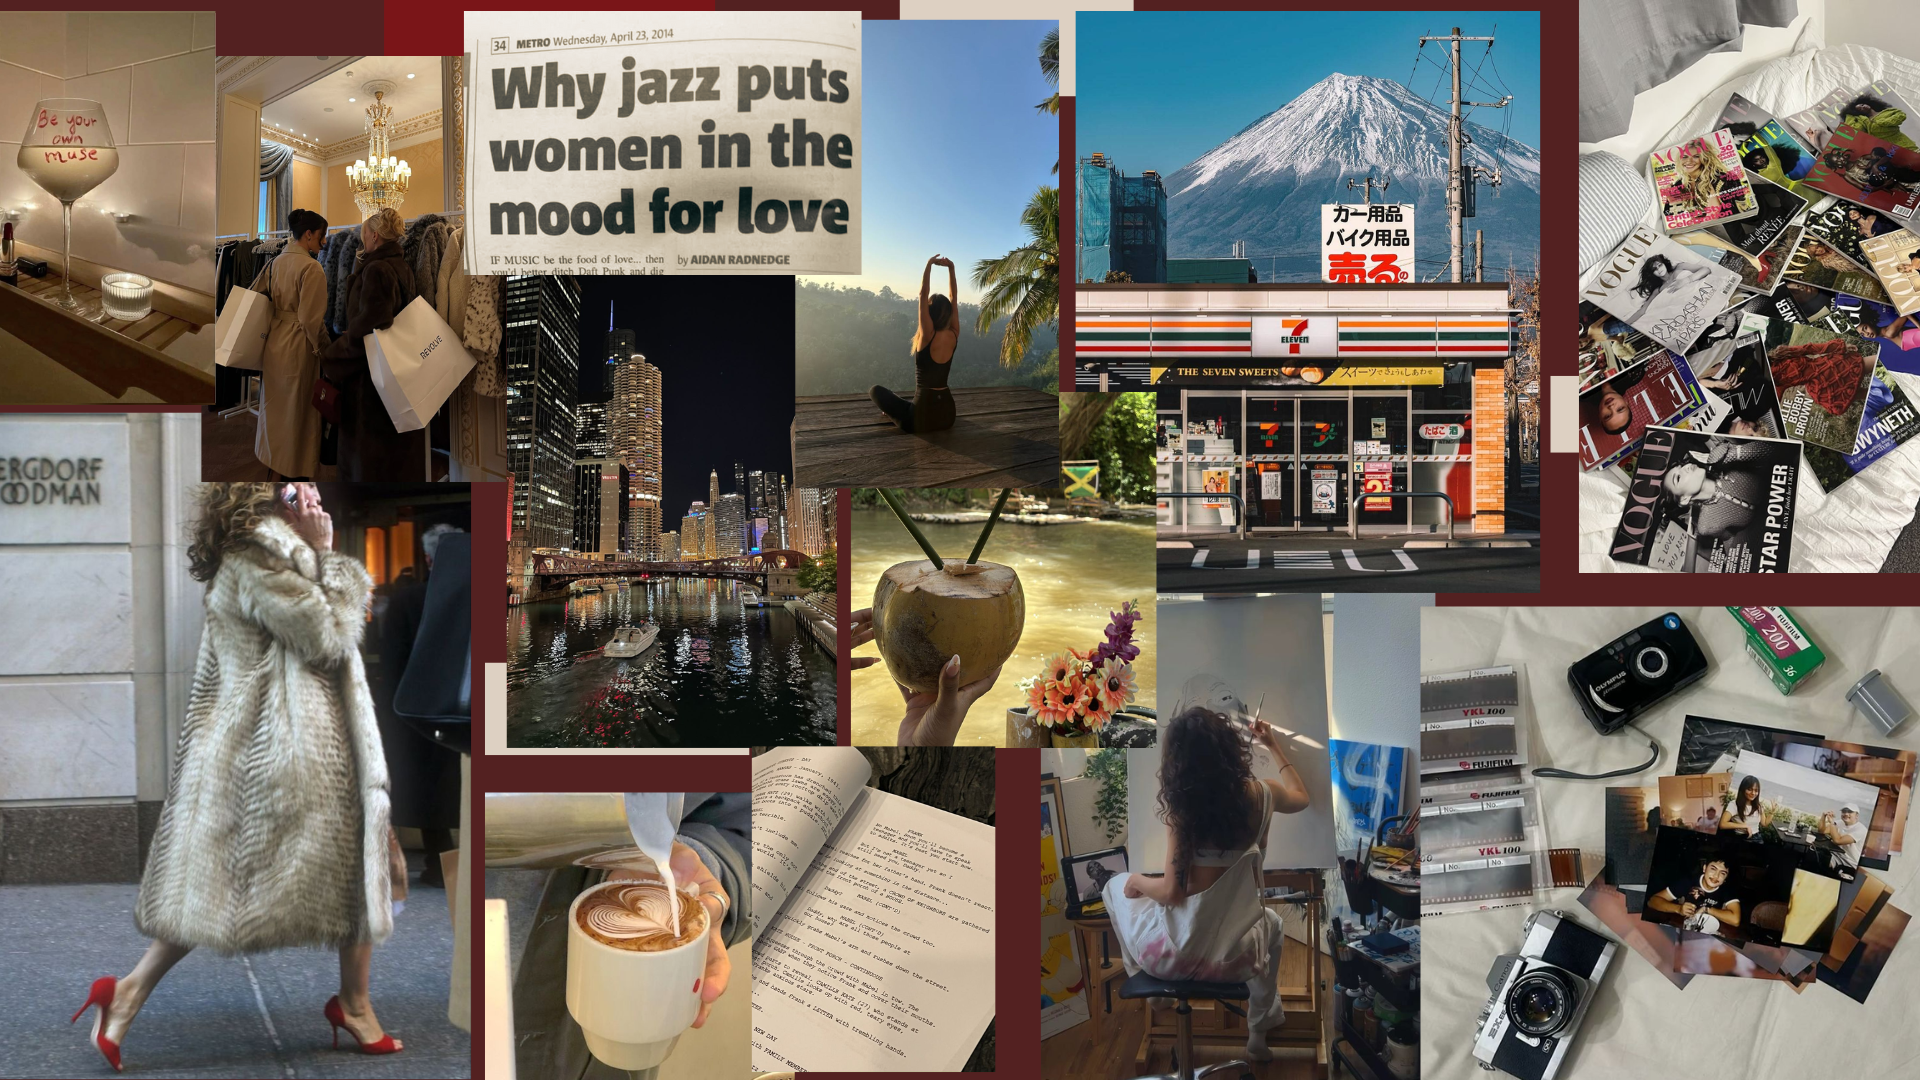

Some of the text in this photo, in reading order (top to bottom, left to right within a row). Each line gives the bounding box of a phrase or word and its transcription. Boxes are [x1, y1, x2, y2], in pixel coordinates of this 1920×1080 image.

[493, 29, 674, 51] 34 METRO Wednesday, April 23, 2014
[491, 56, 849, 119] Why jazz puts
[37, 109, 97, 134] Be your
[52, 133, 83, 145] own
[489, 118, 853, 172] women in the
[1653, 128, 1732, 166] VOGUE
[45, 149, 98, 163] muse
[490, 186, 849, 236] mood for love
[1333, 206, 1403, 222] カー用品
[1666, 202, 1732, 223] British Style
[1667, 210, 1732, 230] Celebration
[1326, 228, 1409, 247] バイク用品
[1740, 220, 1770, 250] Mad about
[1757, 214, 1786, 245] RENÉE
[490, 255, 664, 264] IF MUSIC be the food of love... then
[678, 255, 790, 266] by AIDAN RADNEDGE
[1585, 227, 1658, 299] VOGUE
[579, 267, 598, 275] Daft
[603, 267, 625, 275] Punk
[630, 267, 645, 275] and
[419, 335, 443, 360] REVOLVE
[1178, 368, 1278, 376] THE SEVEN SWEETS
[1787, 391, 1805, 425] BOBBY
[1795, 397, 1814, 436] BROWN
[1425, 426, 1445, 435] たばこ
[1786, 465, 1795, 485] LIGHT
[1613, 431, 1675, 555] VOGUE
[1763, 462, 1791, 528] POWER
[1660, 532, 1676, 554] LOVE
[1666, 552, 1679, 569] YOU
[1760, 624, 1790, 650] 200
[1776, 613, 1800, 640] FUJIFILM
[1782, 664, 1797, 676] 36
[1595, 670, 1627, 694] OLYMPUS
[1462, 707, 1505, 716] YKL 100
[1473, 759, 1513, 769] FUJIFILM
[1481, 789, 1520, 798] FUJIFILM
[1478, 845, 1521, 855] YKL 100
[890, 924, 901, 932] the
[894, 964, 910, 974] down
[911, 971, 923, 980] the
[1492, 960, 1513, 992] Canon
[752, 1025, 778, 1042] NEW DAY
[834, 1016, 850, 1028] with
[850, 1025, 884, 1046] trembling
